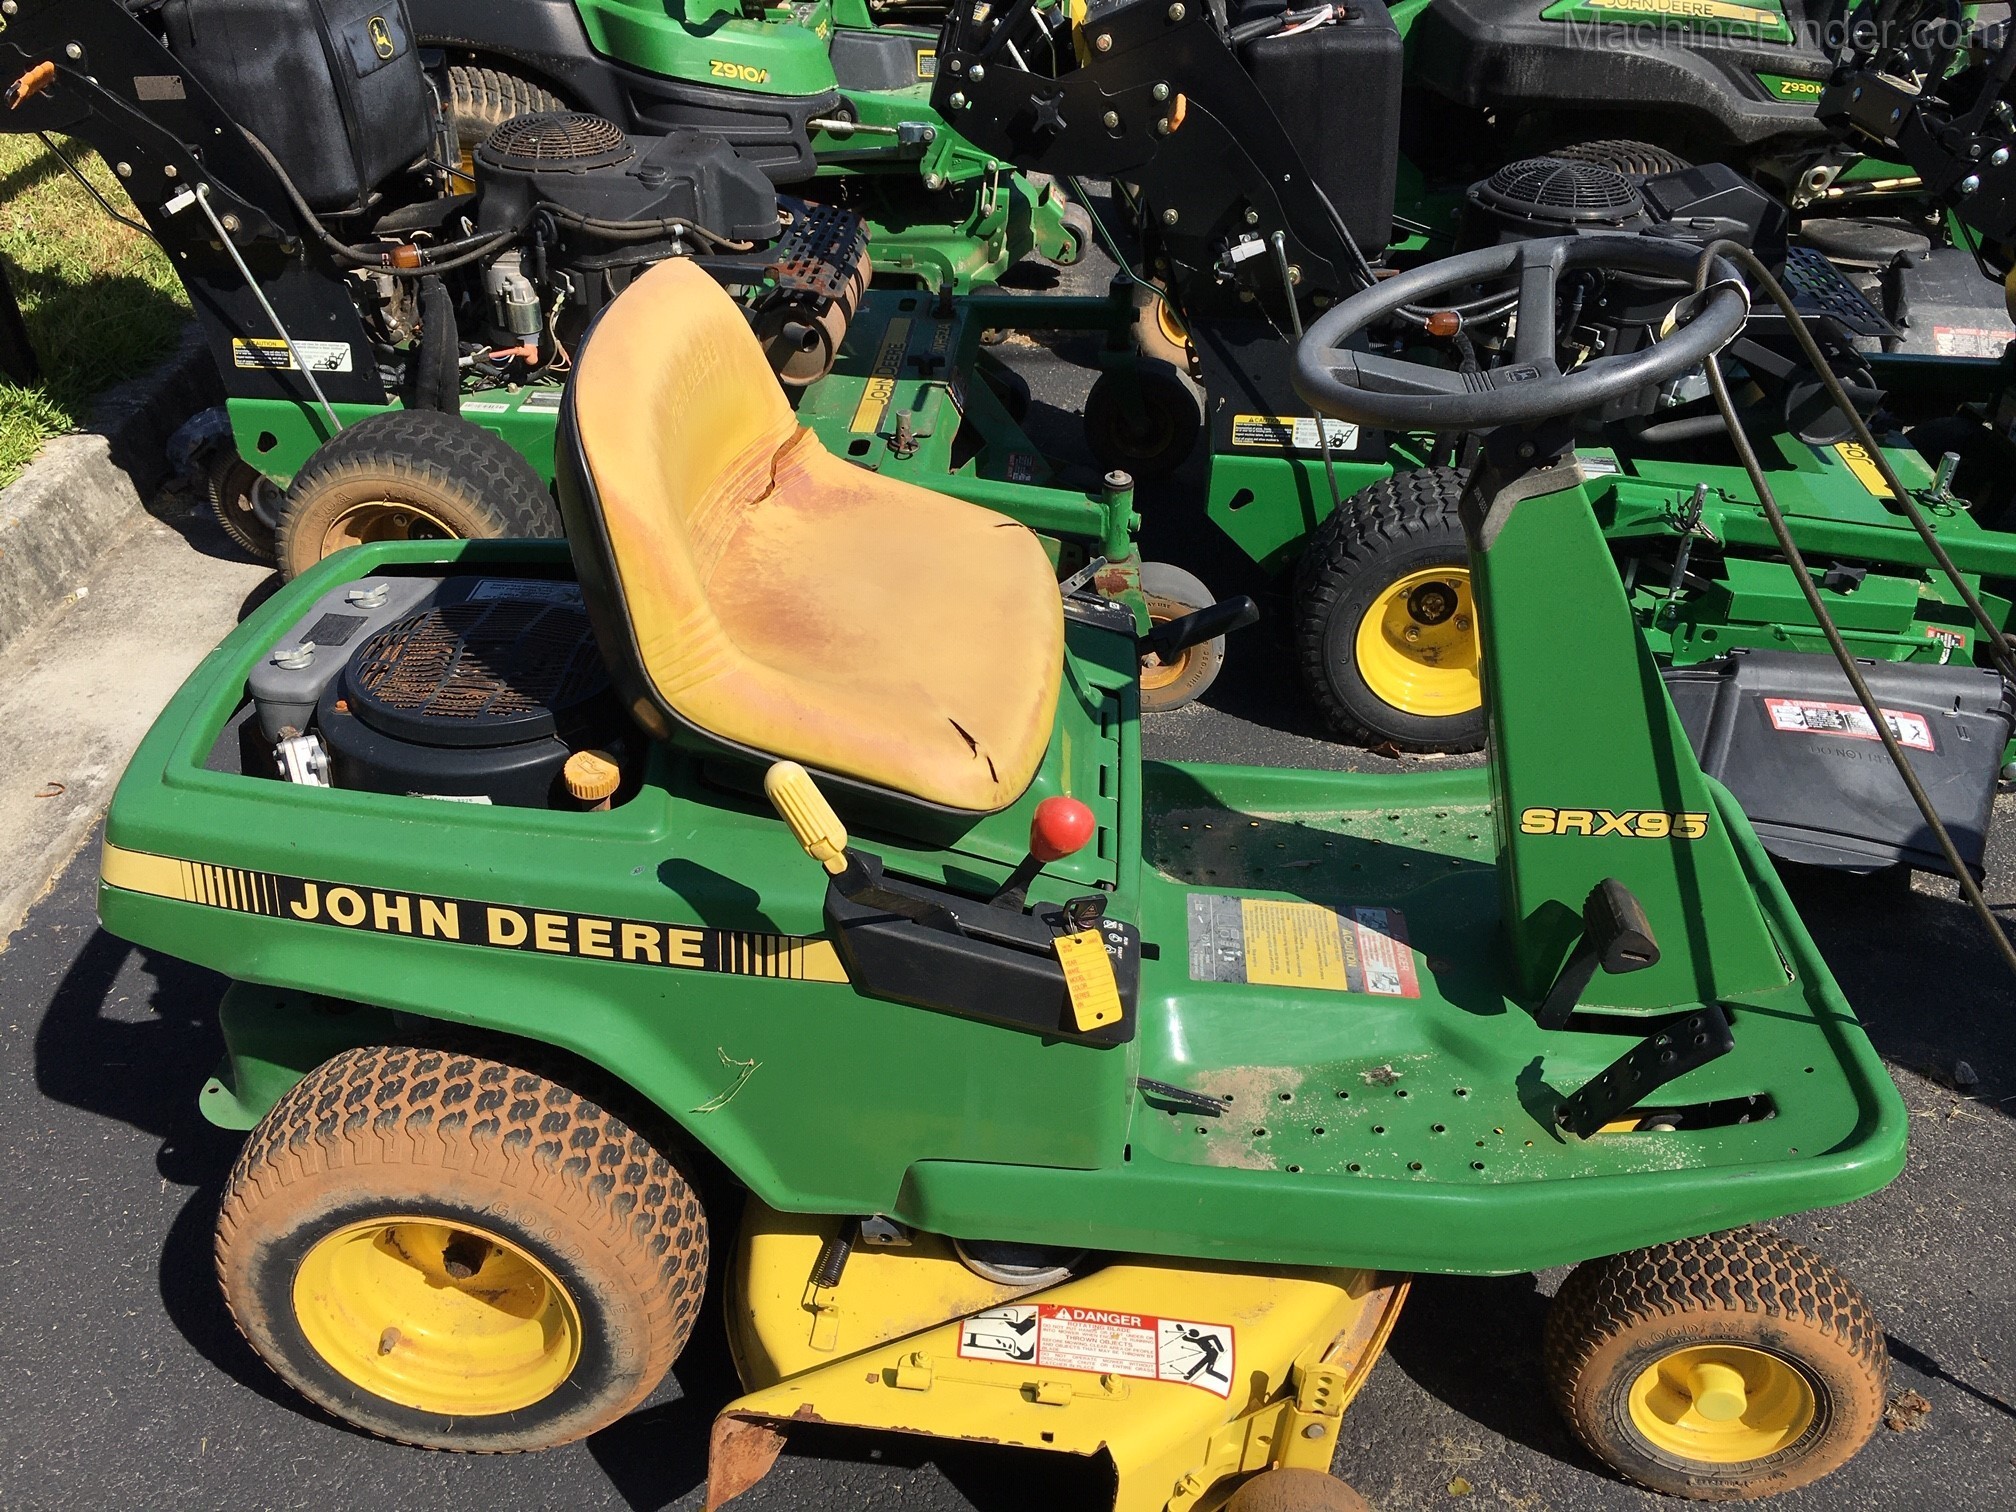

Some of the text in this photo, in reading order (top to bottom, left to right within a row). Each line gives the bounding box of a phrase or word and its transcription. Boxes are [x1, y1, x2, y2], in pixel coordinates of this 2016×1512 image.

[1658, 0, 1714, 16] DEERE
[866, 342, 907, 406] JOHN DEERE
[1520, 807, 1709, 839] SRX95
[290, 883, 706, 968] JOHN DEERE
[1344, 935, 1357, 967] CAUTION
[1065, 959, 1077, 967] YEAR
[1072, 983, 1088, 992] COLOR
[1067, 1321, 1104, 1330] ROTATING
[1073, 1309, 1142, 1327] DANGER
[1099, 1338, 1132, 1347] OBJECTS
